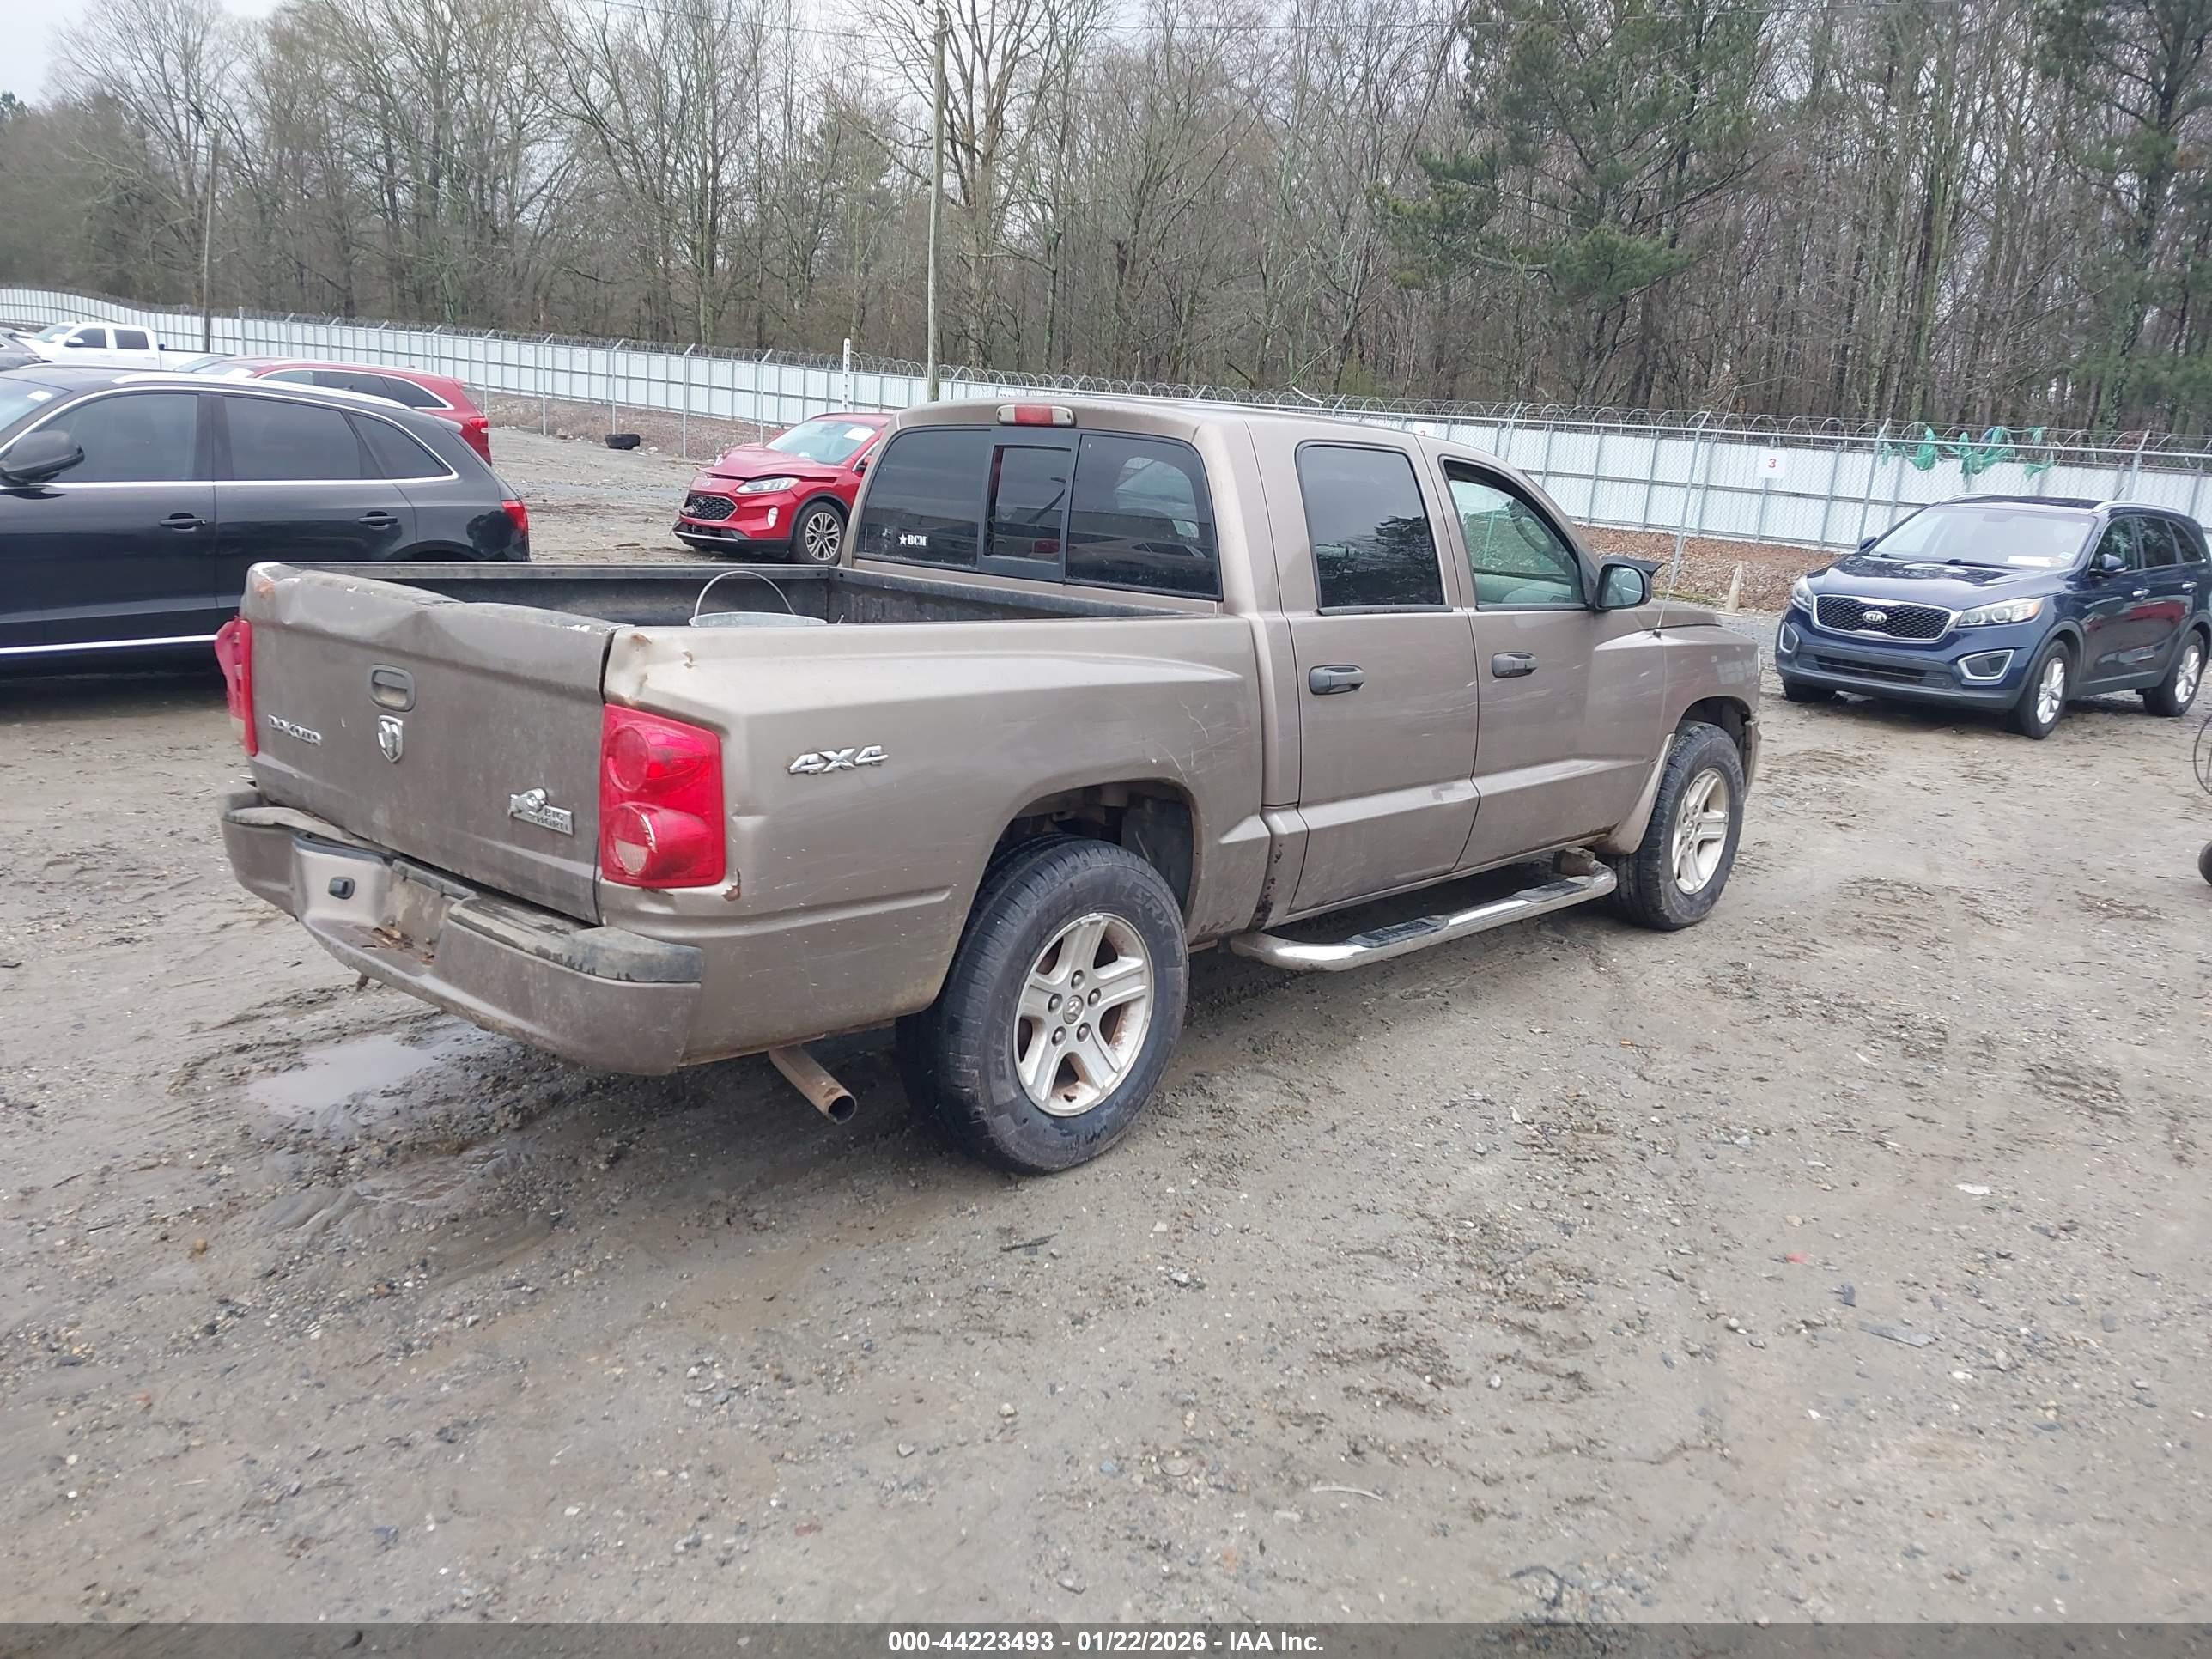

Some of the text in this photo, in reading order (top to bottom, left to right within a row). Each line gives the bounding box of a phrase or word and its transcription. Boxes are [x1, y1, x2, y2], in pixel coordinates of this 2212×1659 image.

[1768, 458, 1777, 469] 3
[1864, 612, 1883, 623] KIA
[788, 744, 889, 774] 4X4
